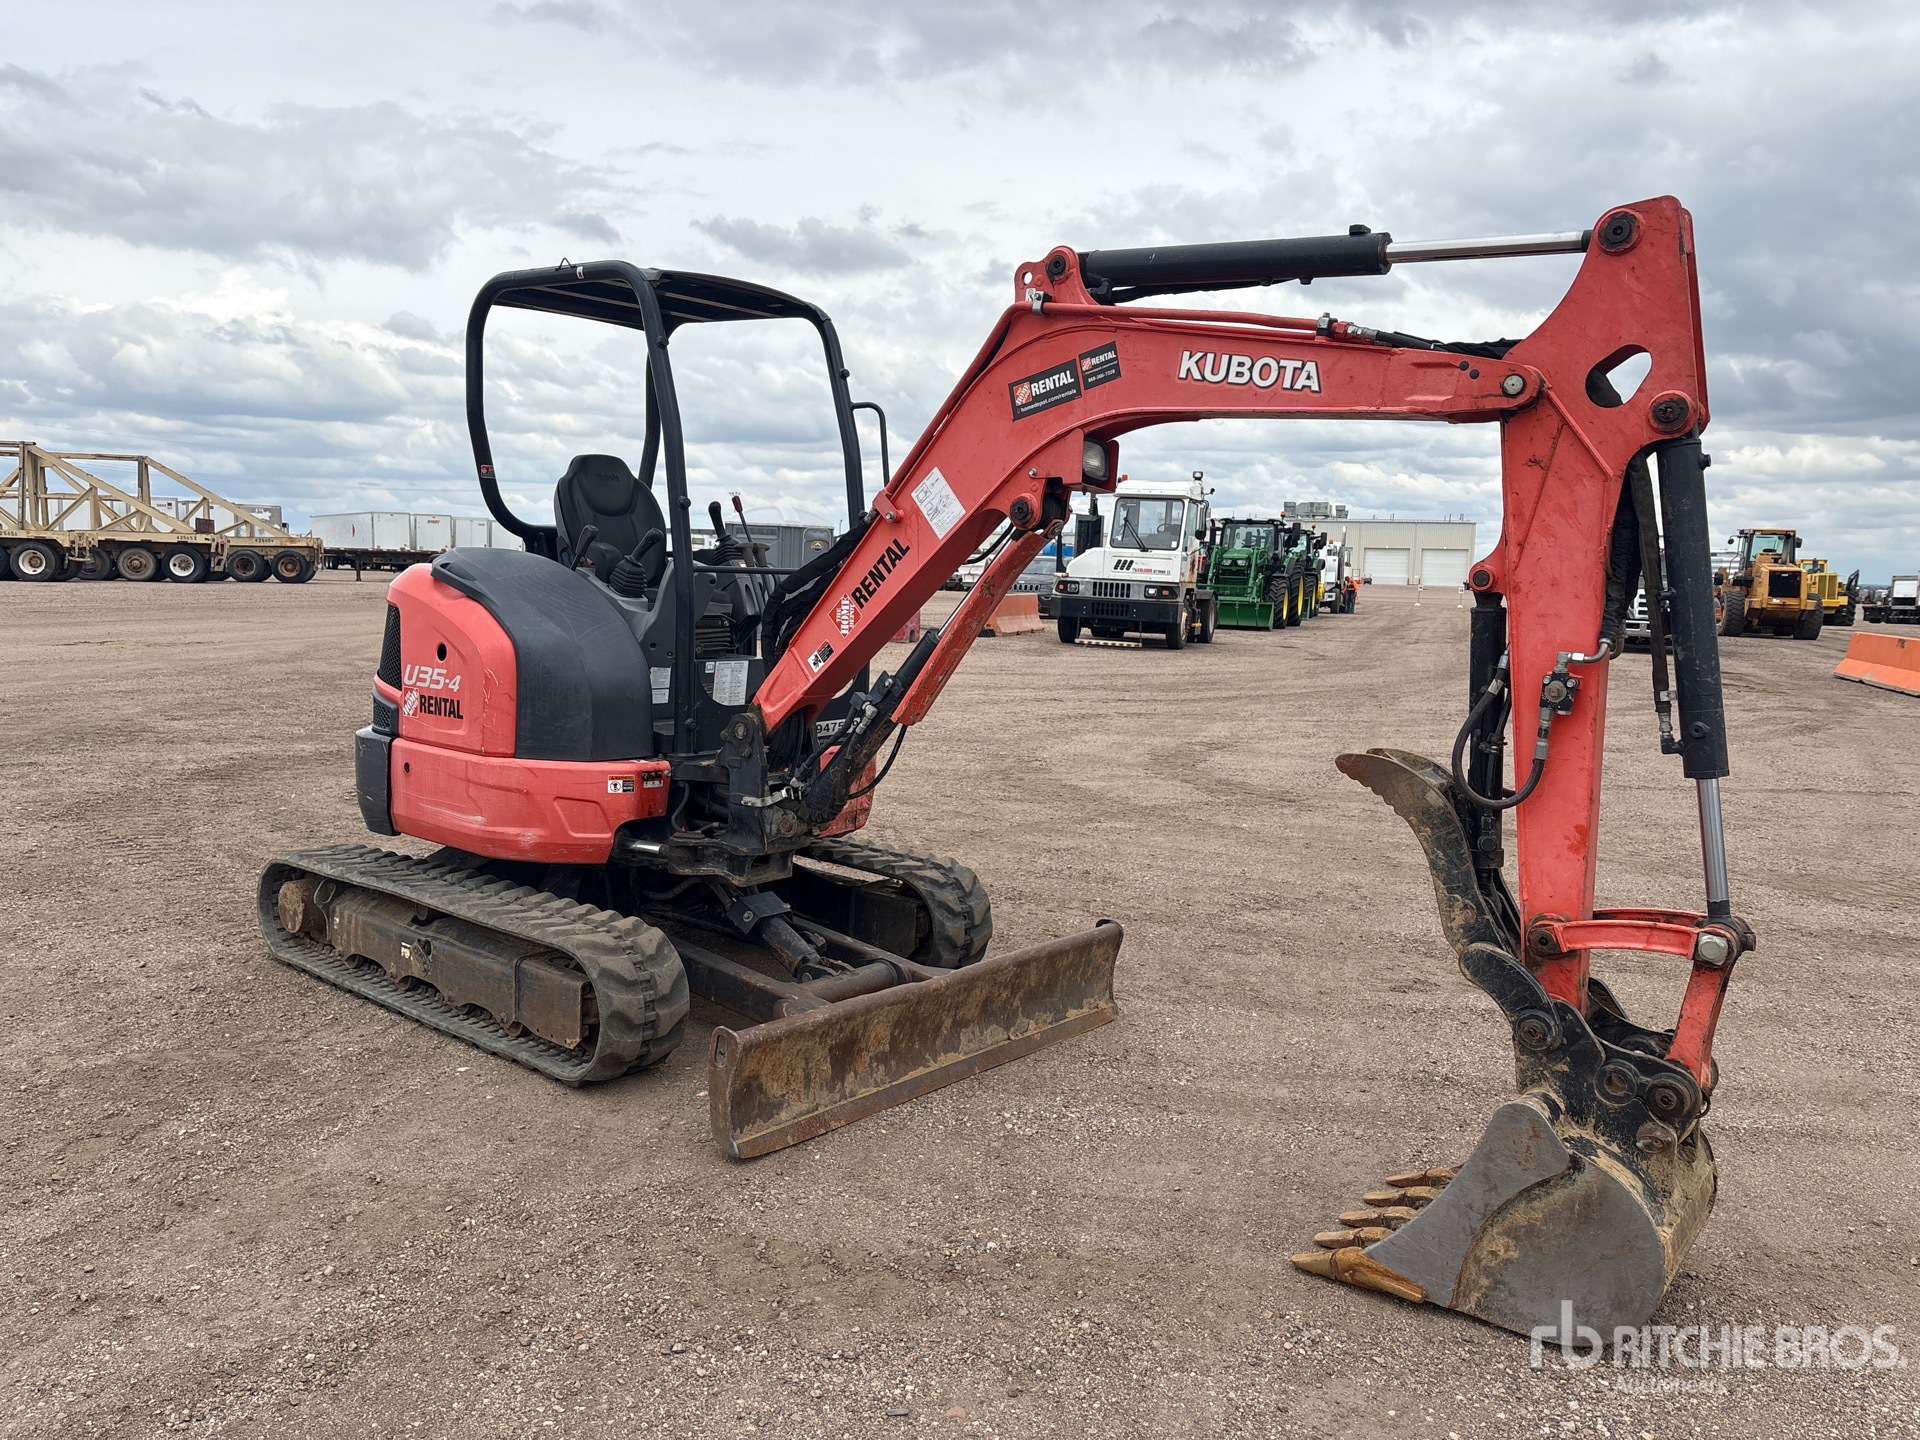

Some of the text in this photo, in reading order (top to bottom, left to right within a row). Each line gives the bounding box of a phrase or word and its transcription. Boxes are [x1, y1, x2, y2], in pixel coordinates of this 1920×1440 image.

[1091, 350, 1116, 366] RENTAL
[1178, 350, 1321, 393] KUBOTA
[1030, 370, 1075, 397] RENTAL
[1020, 388, 1077, 413] homedepot.com/rentals
[850, 538, 911, 609] RENTAL
[840, 596, 850, 635] HOME
[403, 664, 462, 693] U35-4
[419, 694, 464, 720] RENTAL
